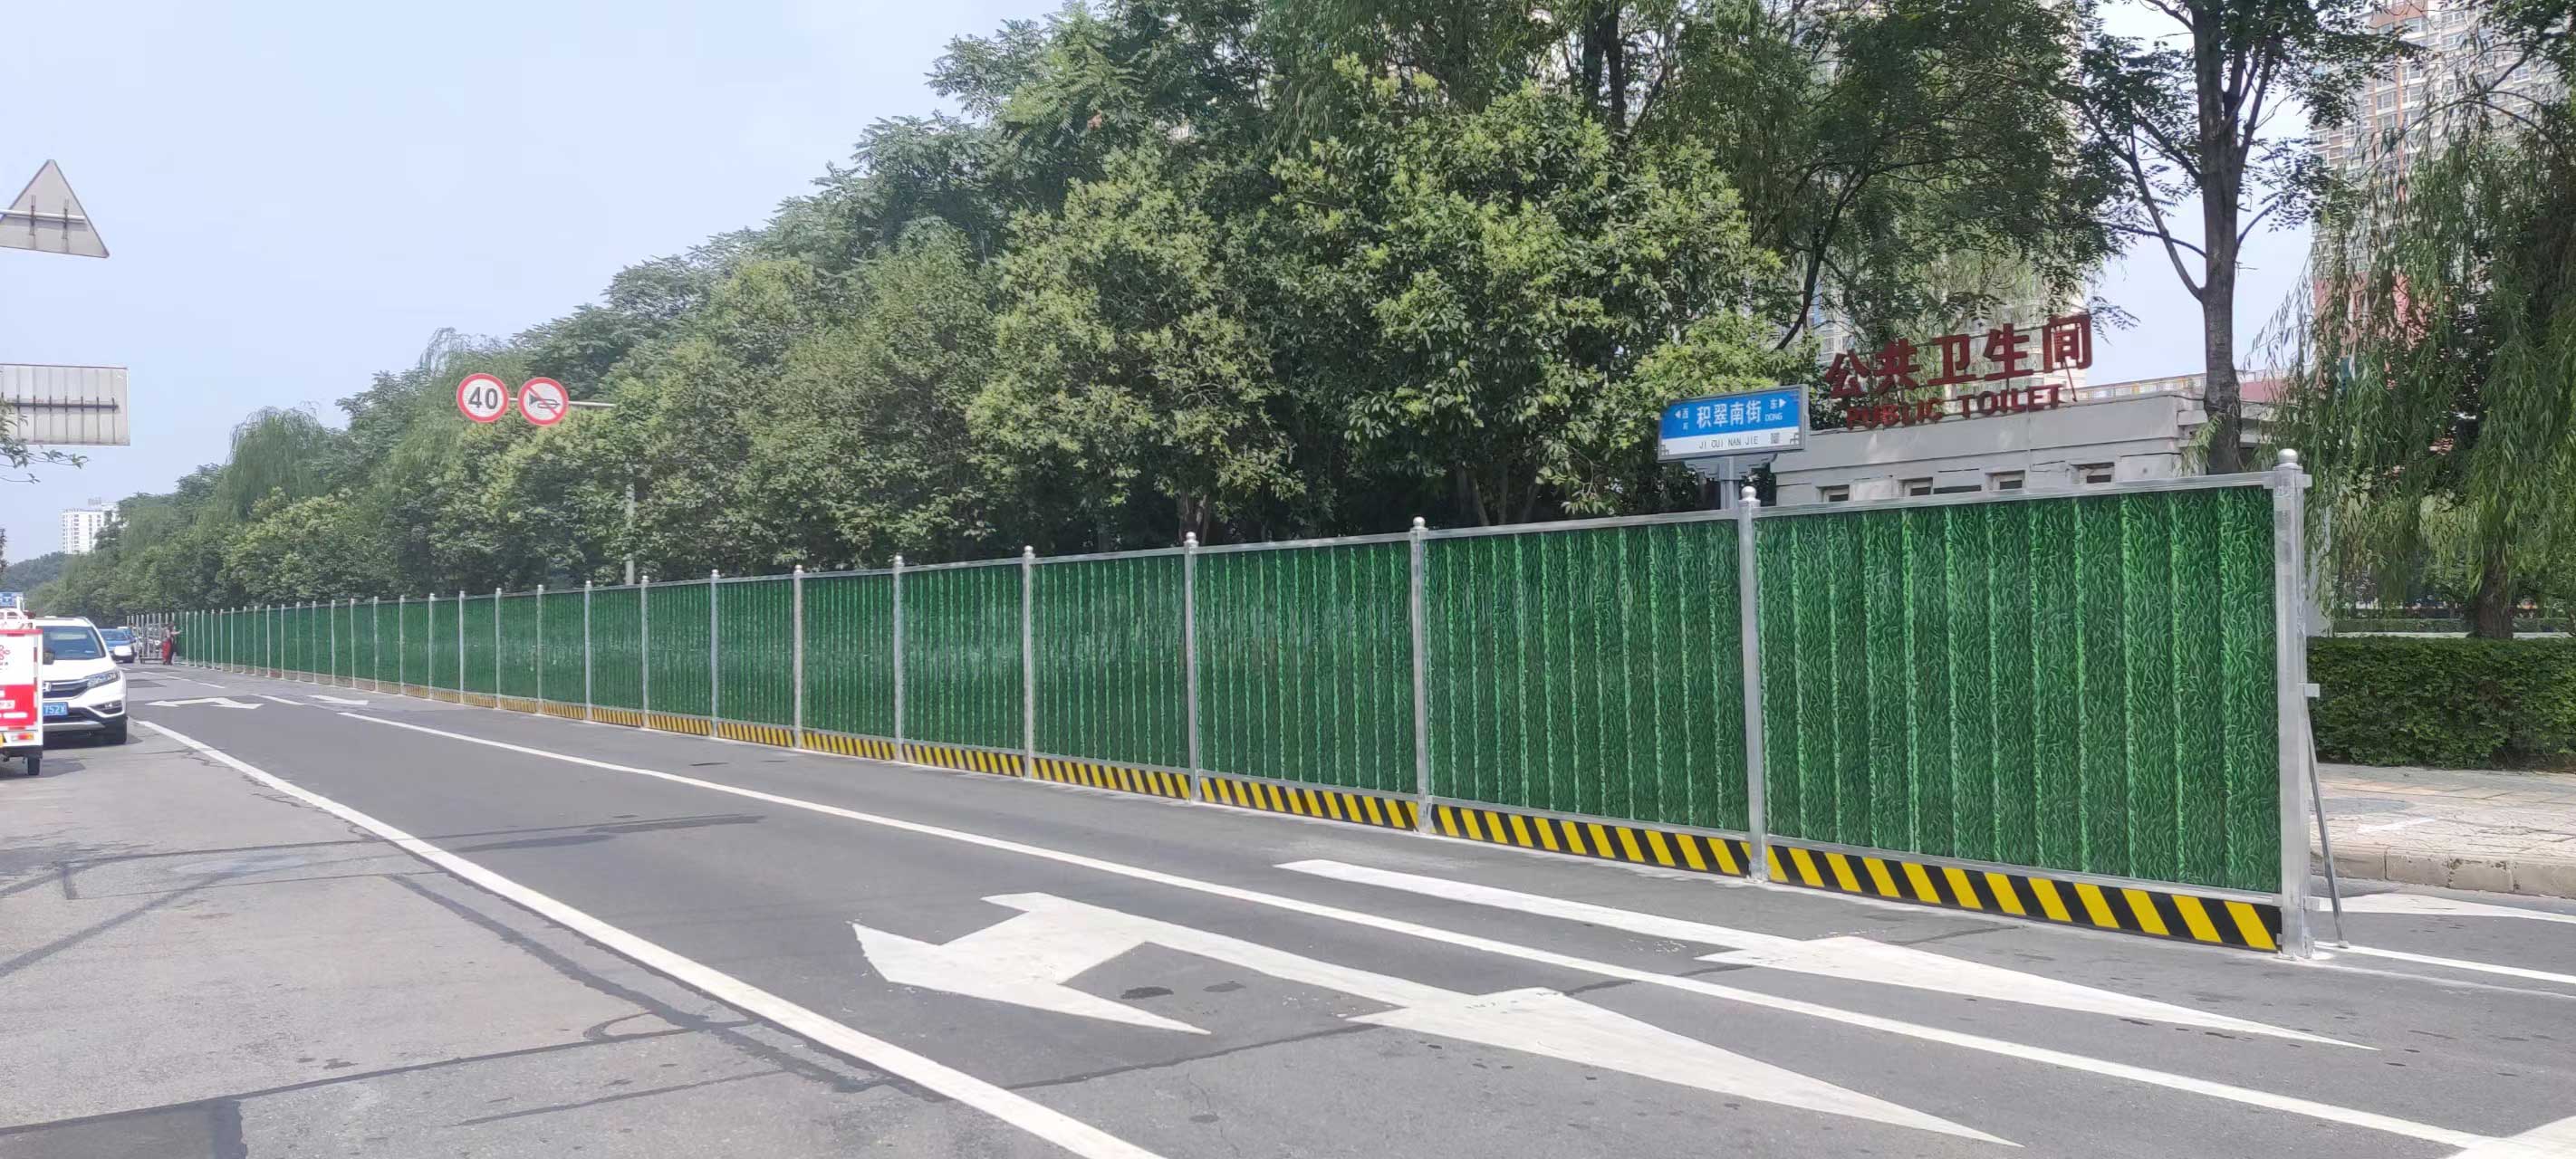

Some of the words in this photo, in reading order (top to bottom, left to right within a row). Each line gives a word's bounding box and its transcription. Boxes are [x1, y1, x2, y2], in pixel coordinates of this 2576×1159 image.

[1825, 312, 2092, 398] 公共卫生间
[468, 387, 498, 410] 40
[1846, 398, 1943, 430] PUBLIC
[1956, 384, 2062, 419] TOILET
[1697, 400, 1762, 429] 积翠南街
[1727, 437, 1741, 447] NAN
[1745, 436, 1759, 445] JIE
